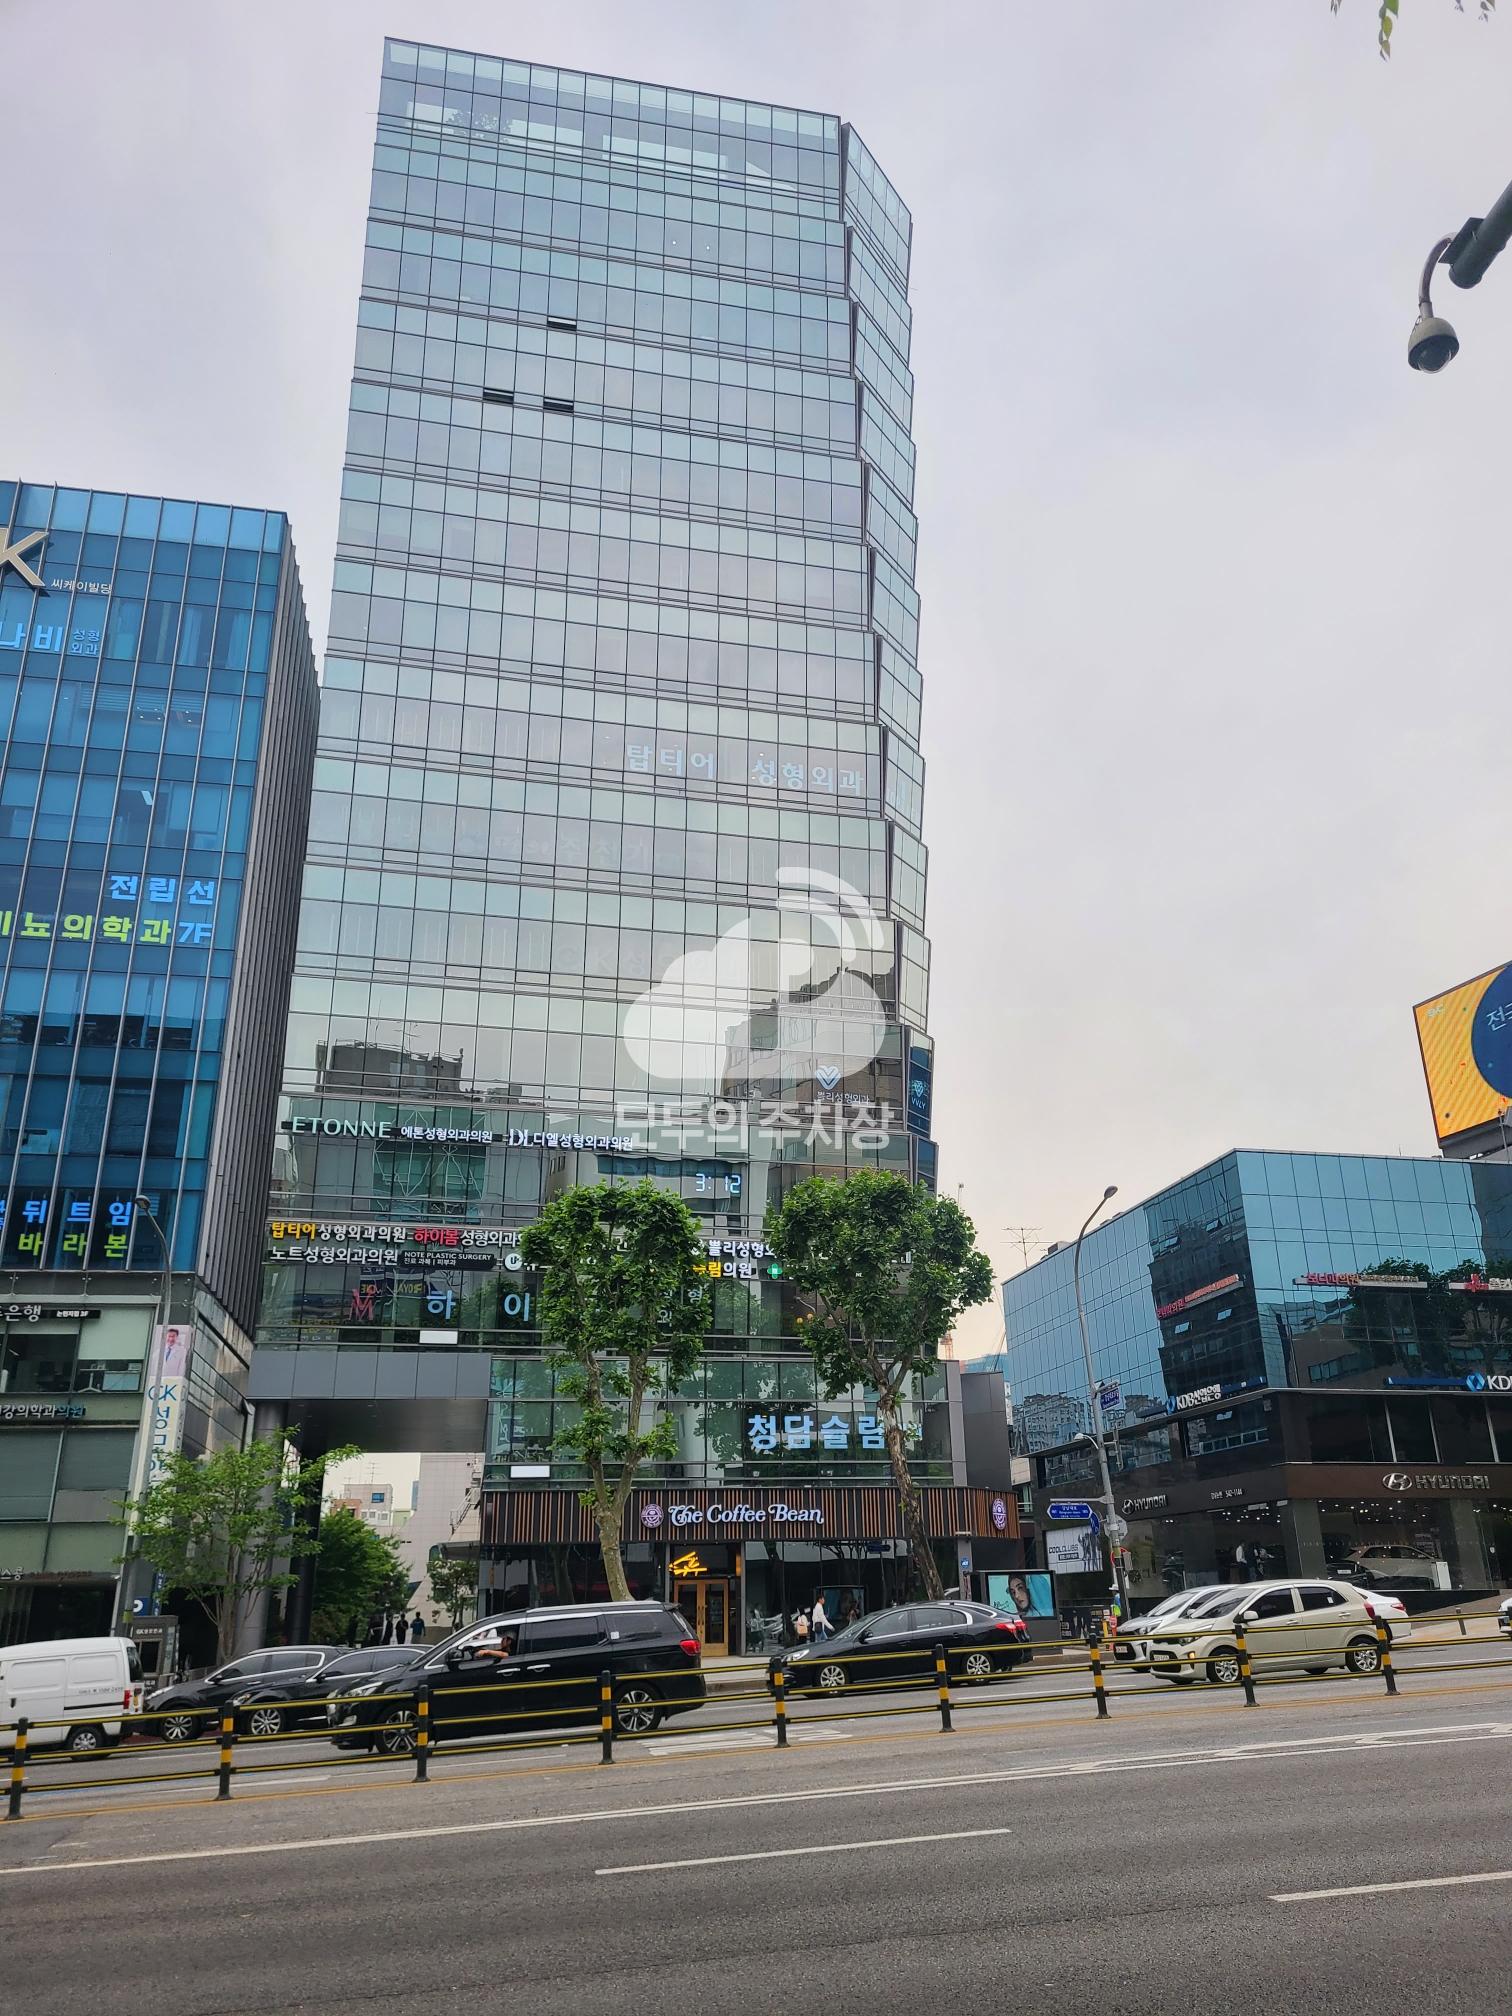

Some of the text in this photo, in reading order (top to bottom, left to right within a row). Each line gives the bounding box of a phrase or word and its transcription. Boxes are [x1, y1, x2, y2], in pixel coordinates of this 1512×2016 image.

[51, 579, 112, 594] 씨케이빌딩
[73, 628, 99, 641] 성형
[71, 642, 98, 656] 외과
[626, 744, 863, 796] 탑티어 성형외과
[109, 875, 214, 905] 전립선
[292, 1116, 391, 1138] ETONNE
[401, 1126, 492, 1144] 에톤성형외과의원
[22, 1199, 131, 1226] 뒤트임
[18, 1232, 127, 1258] 바라본
[270, 1246, 398, 1266] 노트성형외과의원
[458, 1253, 492, 1261] SURGERY
[1415, 1475, 1490, 1489] HYUNDAI
[1134, 1494, 1168, 1511] HYUNDAI
[668, 1505, 703, 1526] The
[706, 1504, 766, 1523] Coffee
[768, 1503, 824, 1525] Bean
